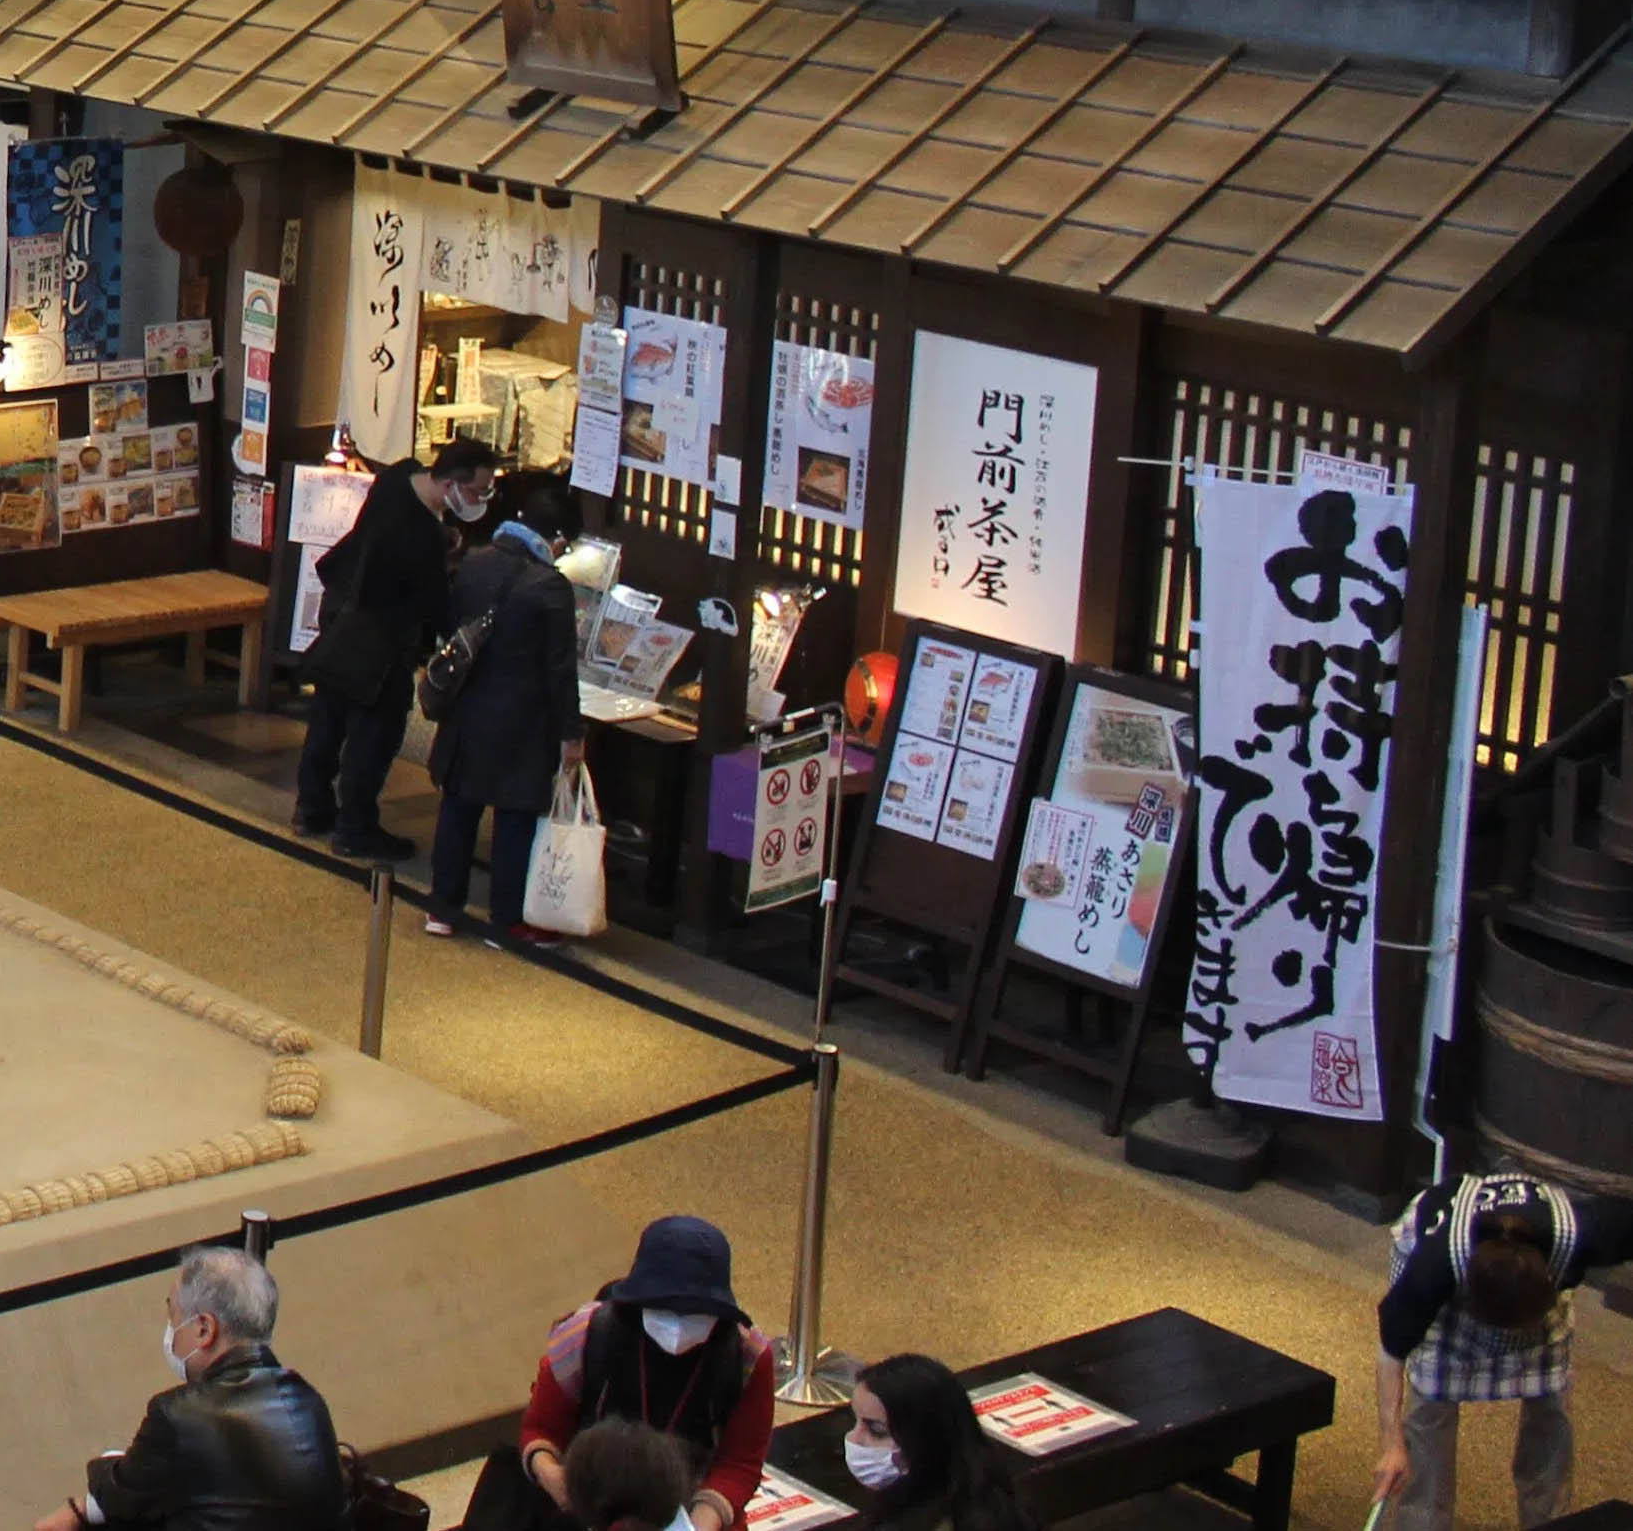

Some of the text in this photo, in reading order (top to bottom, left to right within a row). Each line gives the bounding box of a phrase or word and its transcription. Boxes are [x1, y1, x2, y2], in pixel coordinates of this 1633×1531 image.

[51, 154, 99, 316] 深川めし
[38, 256, 53, 330] 深川めし
[369, 209, 404, 418] 深川めし
[961, 388, 1025, 608] 門前茶屋
[1131, 785, 1163, 836] 深川
[1074, 846, 1114, 956] 蒸籠めし
[1110, 839, 1141, 920] あさり
